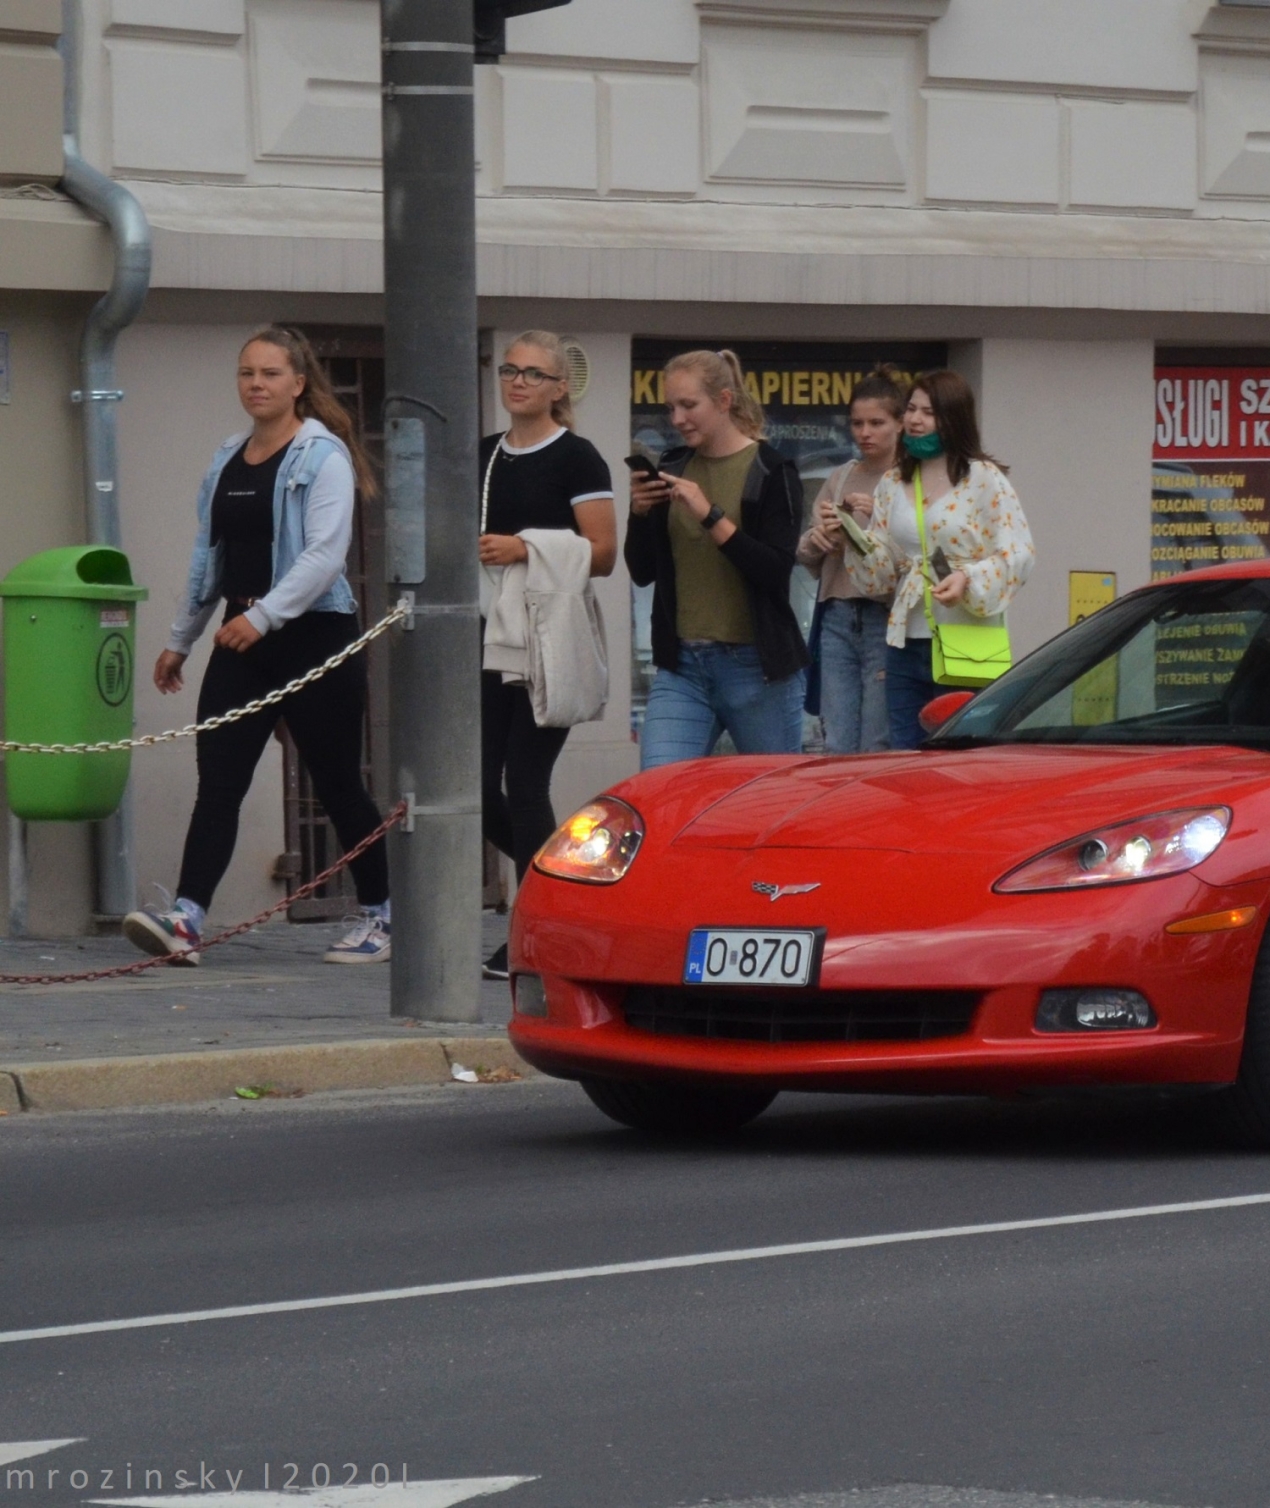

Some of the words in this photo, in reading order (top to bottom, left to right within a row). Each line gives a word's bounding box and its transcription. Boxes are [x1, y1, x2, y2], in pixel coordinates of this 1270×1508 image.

[1152, 378, 1229, 448] SŁUGI
[1239, 421, 1247, 447] I
[1199, 472, 1246, 488] FLEKÓW
[1151, 498, 1207, 512] KRACANIE
[1209, 496, 1266, 511] OBCASÓW
[1151, 522, 1213, 536] OCOWANIE
[1214, 520, 1270, 535] OBCASÓW
[1152, 547, 1219, 563] OZCIĄGANIE
[1221, 545, 1265, 559] OBUWIA
[1157, 625, 1201, 639] LEJENIE
[1157, 649, 1214, 664] SZYWANIE
[1157, 673, 1209, 685] STRZENIE
[738, 938, 802, 978] 870
[688, 962, 702, 974] PL
